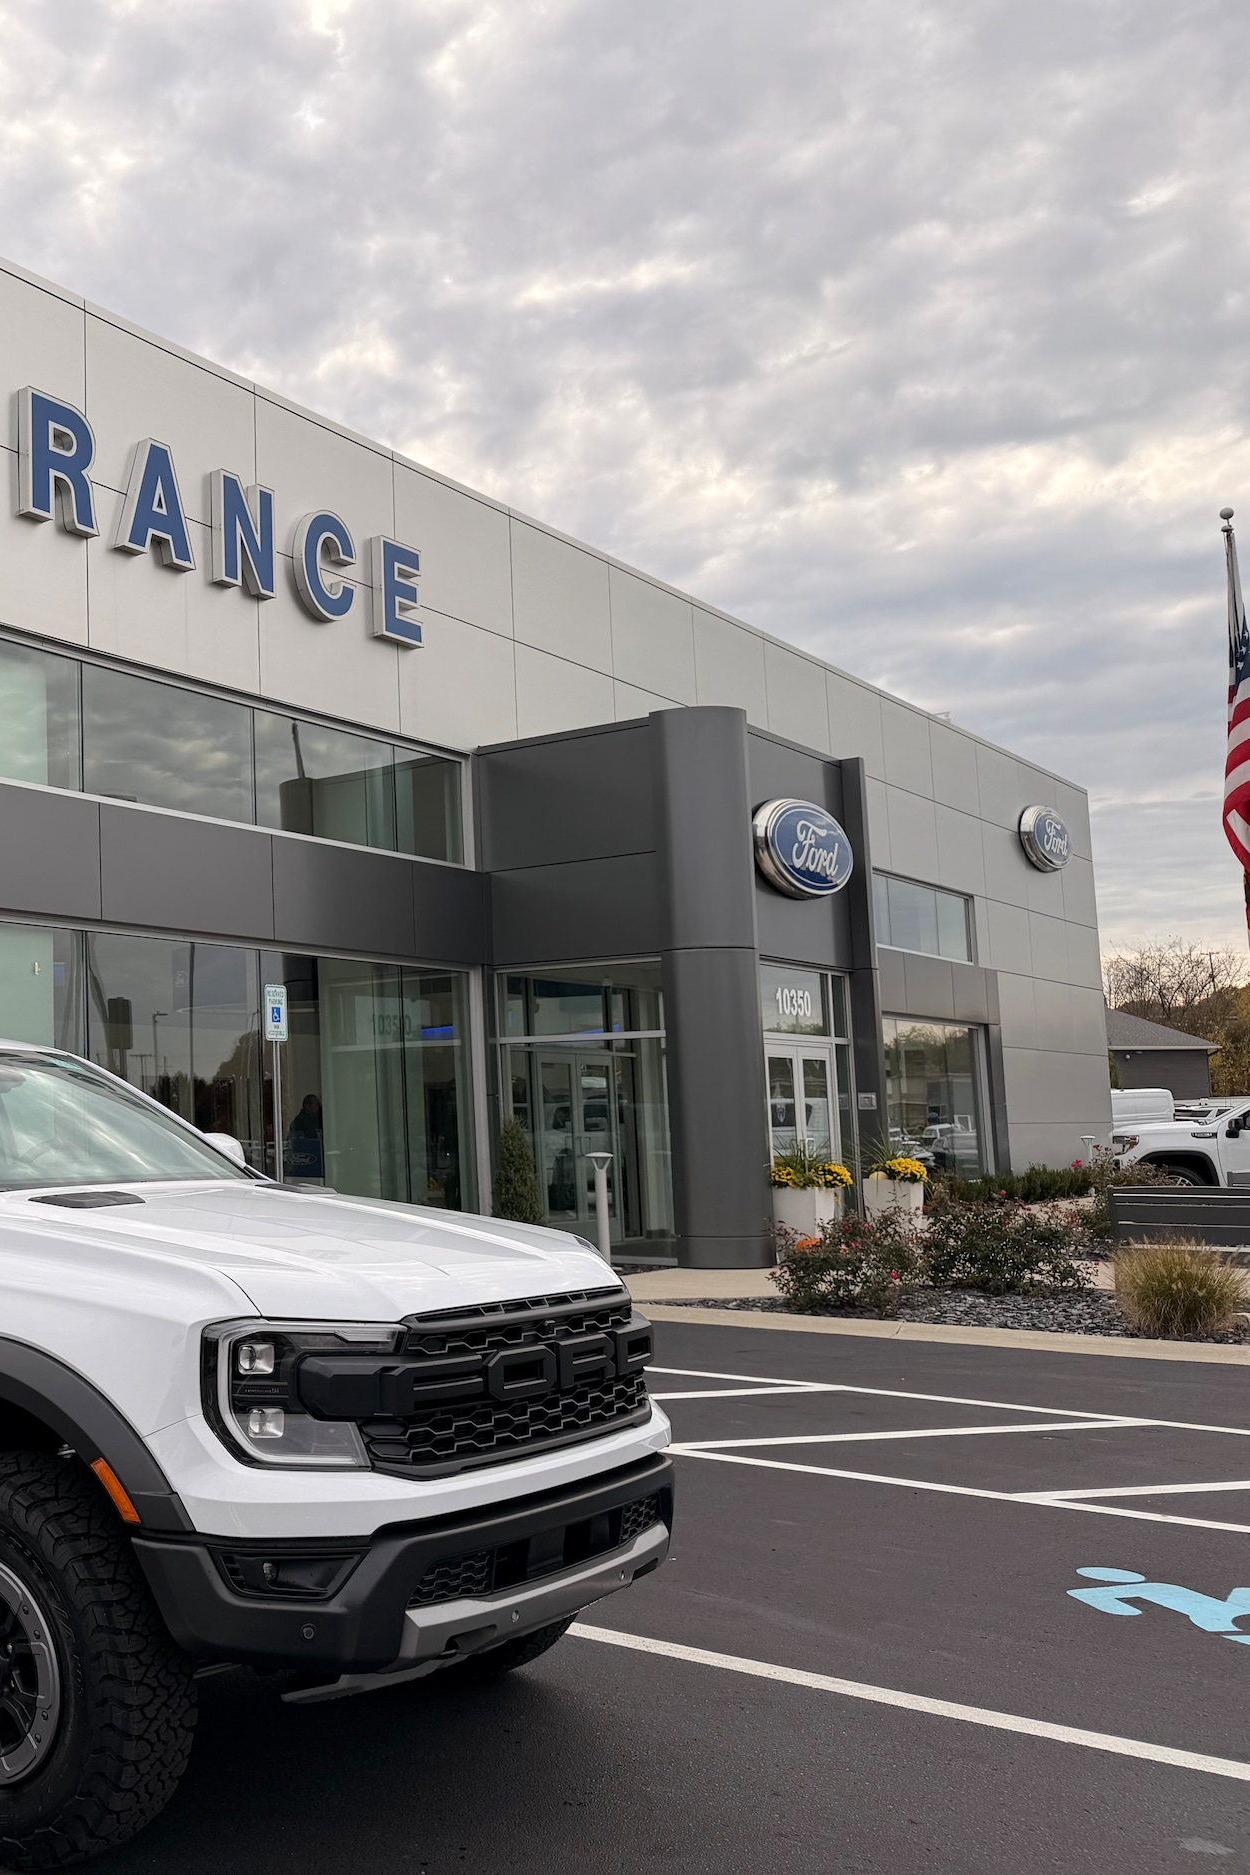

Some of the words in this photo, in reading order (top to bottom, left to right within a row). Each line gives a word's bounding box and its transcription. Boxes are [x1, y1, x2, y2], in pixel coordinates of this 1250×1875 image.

[792, 820, 839, 877] Ford
[1044, 819, 1068, 856] Ford
[776, 987, 811, 1017] 10350
[382, 1320, 654, 1417] FORD
